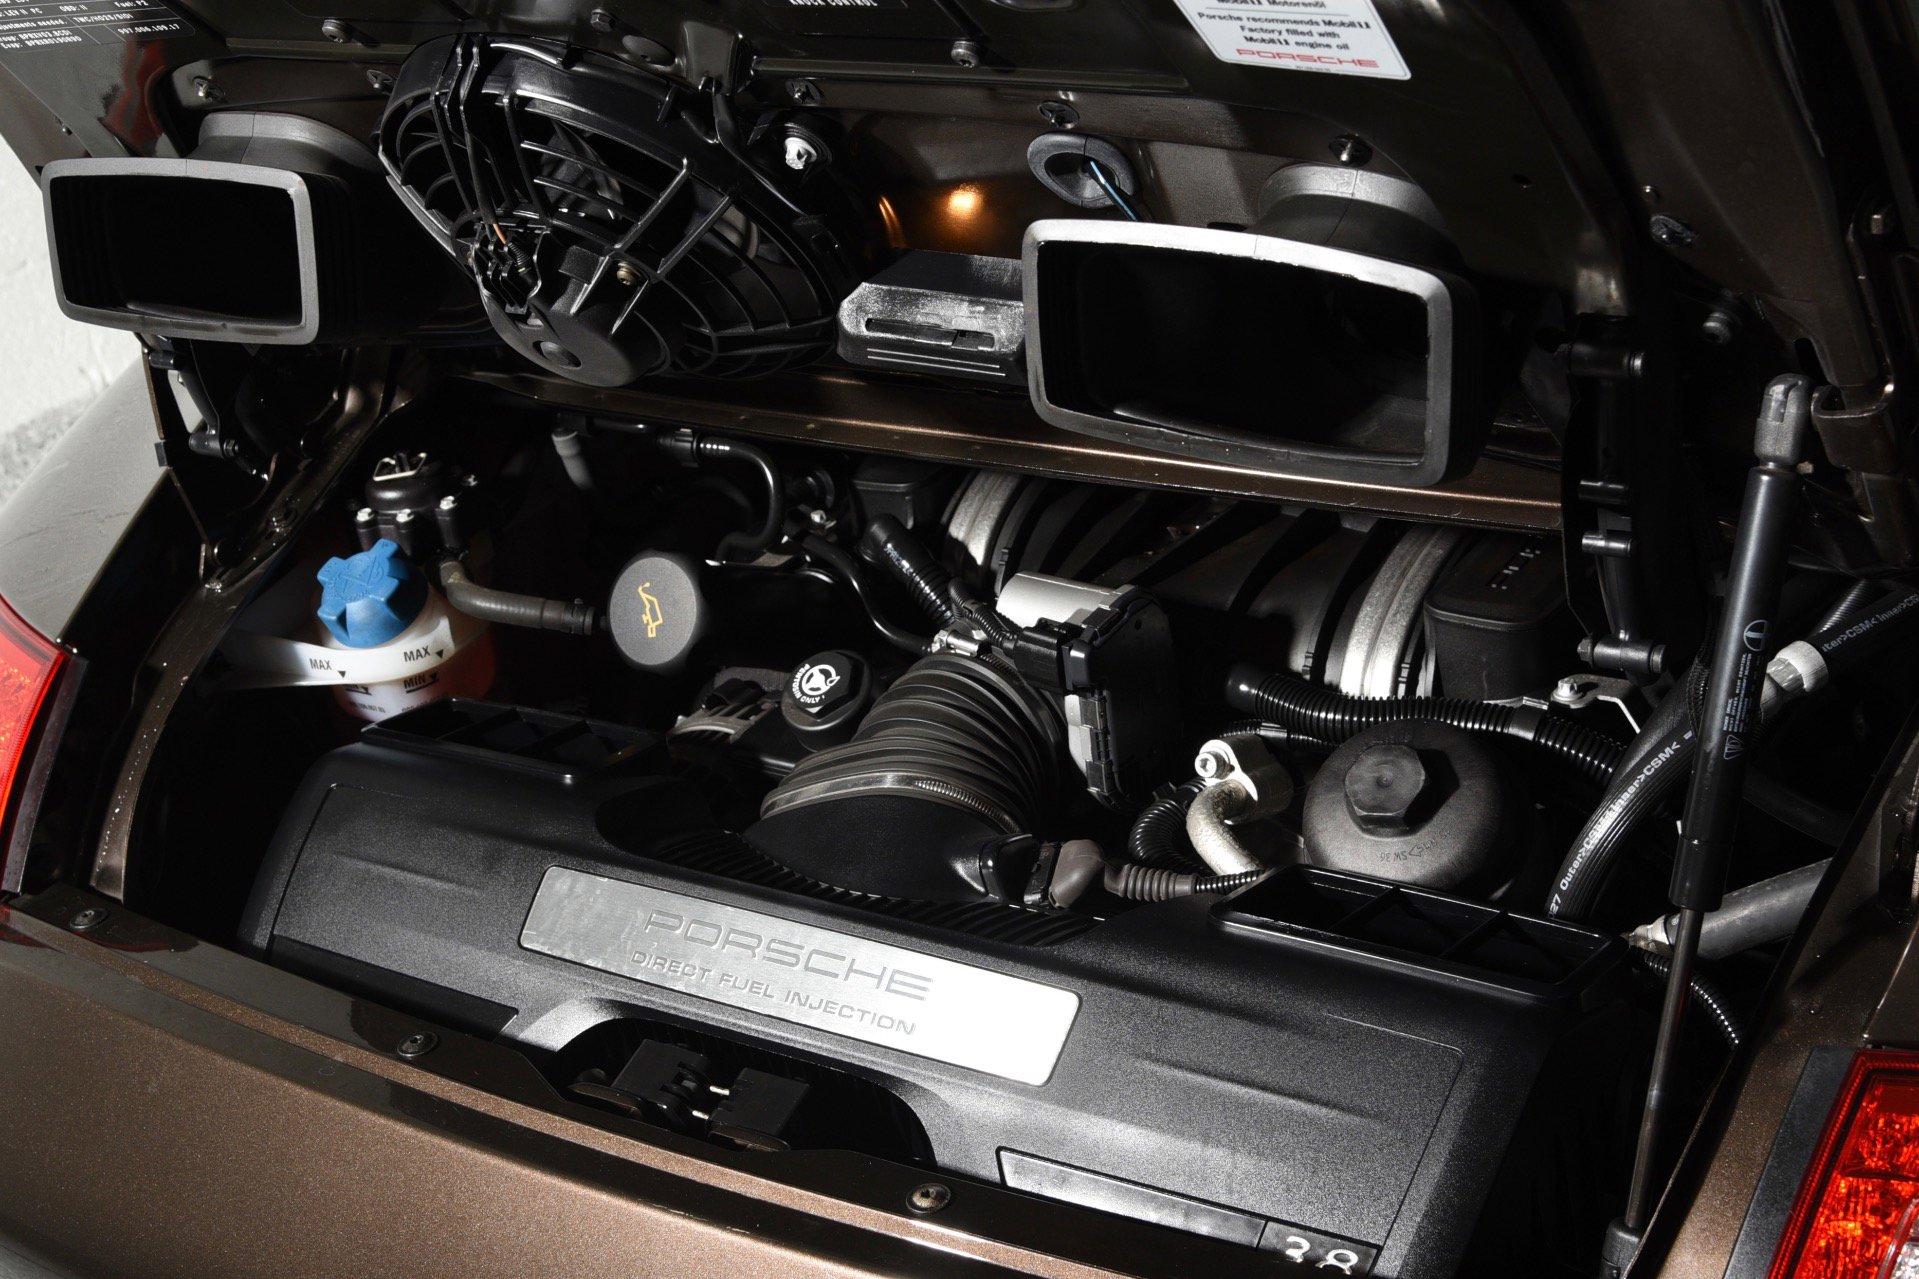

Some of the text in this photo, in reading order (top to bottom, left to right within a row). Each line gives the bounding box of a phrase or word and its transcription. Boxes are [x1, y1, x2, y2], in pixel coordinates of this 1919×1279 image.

[1197, 12, 1243, 22] Porsche
[1246, 16, 1320, 26] recommends
[1240, 25, 1282, 36] Factory
[1285, 28, 1314, 37] filled
[1294, 41, 1332, 49] engine
[1236, 49, 1379, 68] PORSCHE
[403, 646, 431, 662] MAX
[309, 658, 333, 671] MAX
[403, 673, 426, 690] MIN
[800, 695, 820, 703] ONLY
[644, 909, 934, 1001] PORSCHE
[631, 951, 917, 1036] DIRECT FUEL INJECTION
